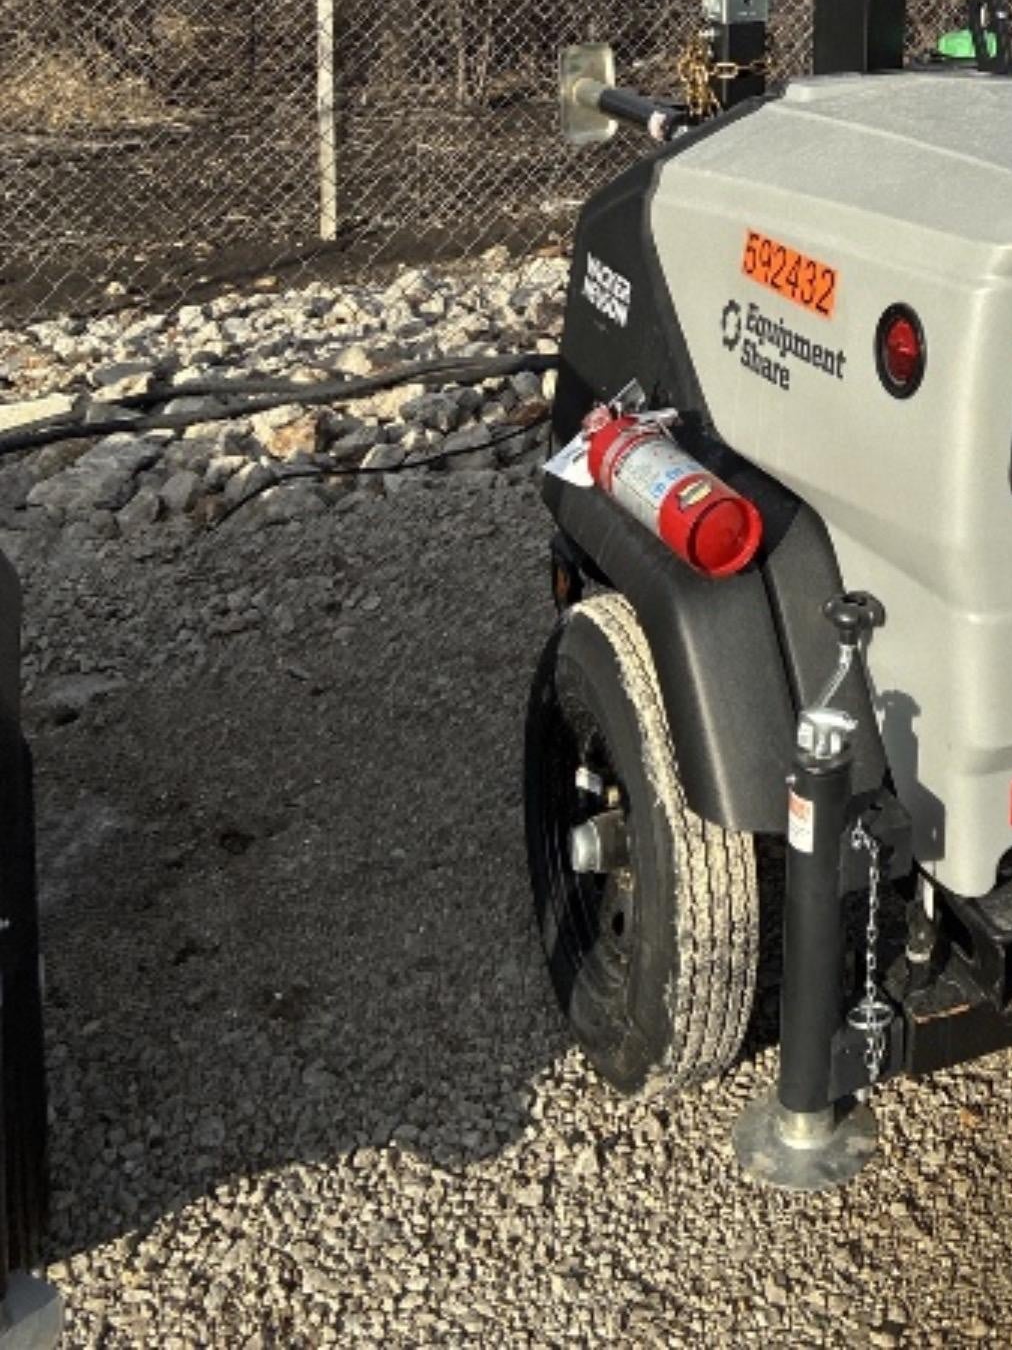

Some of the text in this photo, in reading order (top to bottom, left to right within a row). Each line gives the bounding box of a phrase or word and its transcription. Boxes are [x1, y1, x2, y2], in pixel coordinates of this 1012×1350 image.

[743, 230, 837, 316] 592432
[740, 337, 790, 391] Share
[745, 301, 847, 380] Equipment
